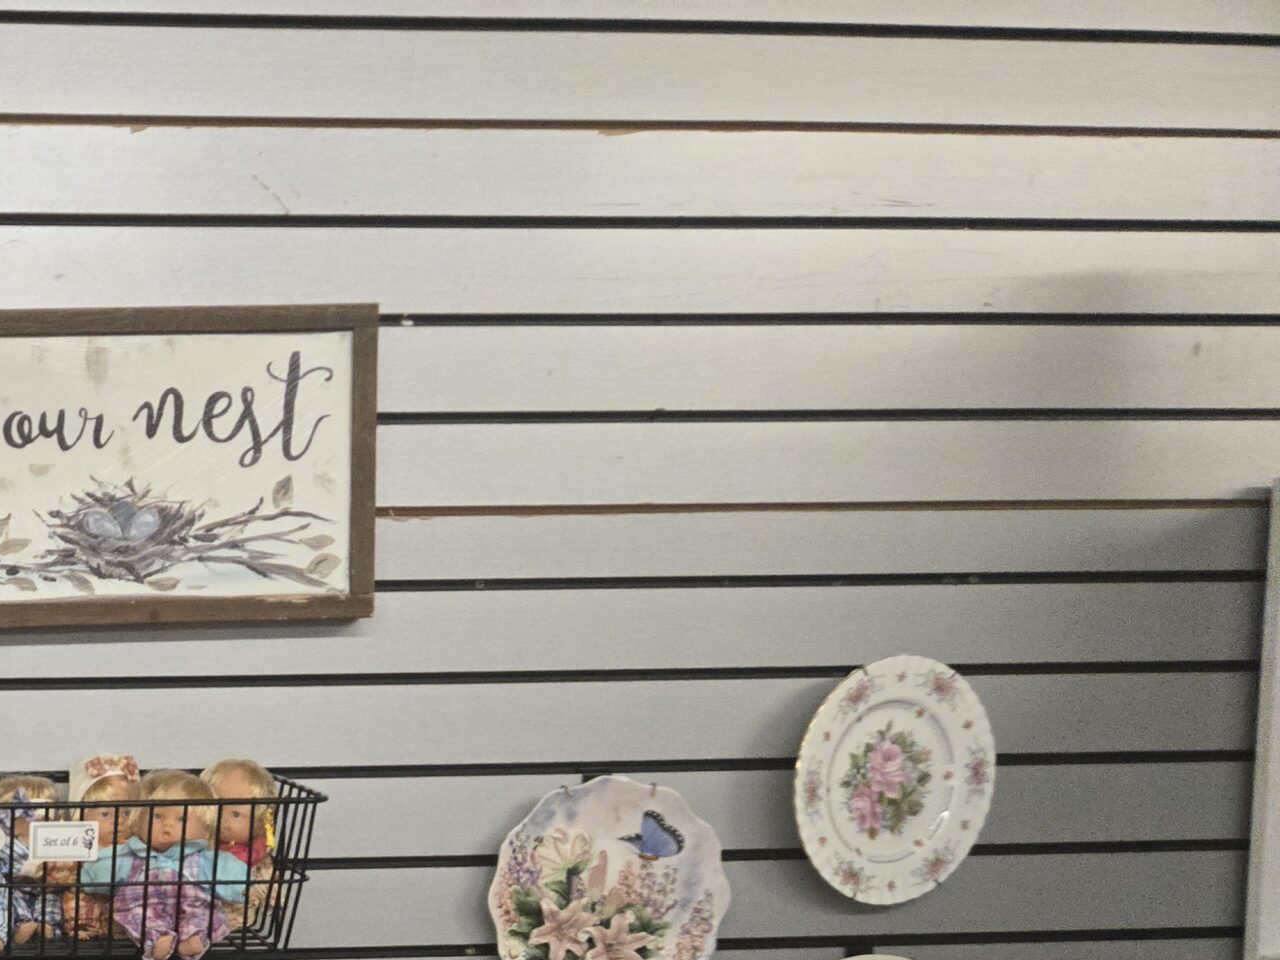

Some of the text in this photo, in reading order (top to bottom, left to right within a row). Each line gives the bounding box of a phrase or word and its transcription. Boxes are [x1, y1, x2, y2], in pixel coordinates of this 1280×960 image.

[2, 405, 115, 452] our
[131, 350, 334, 468] nest
[43, 835, 79, 847] Set of 6
